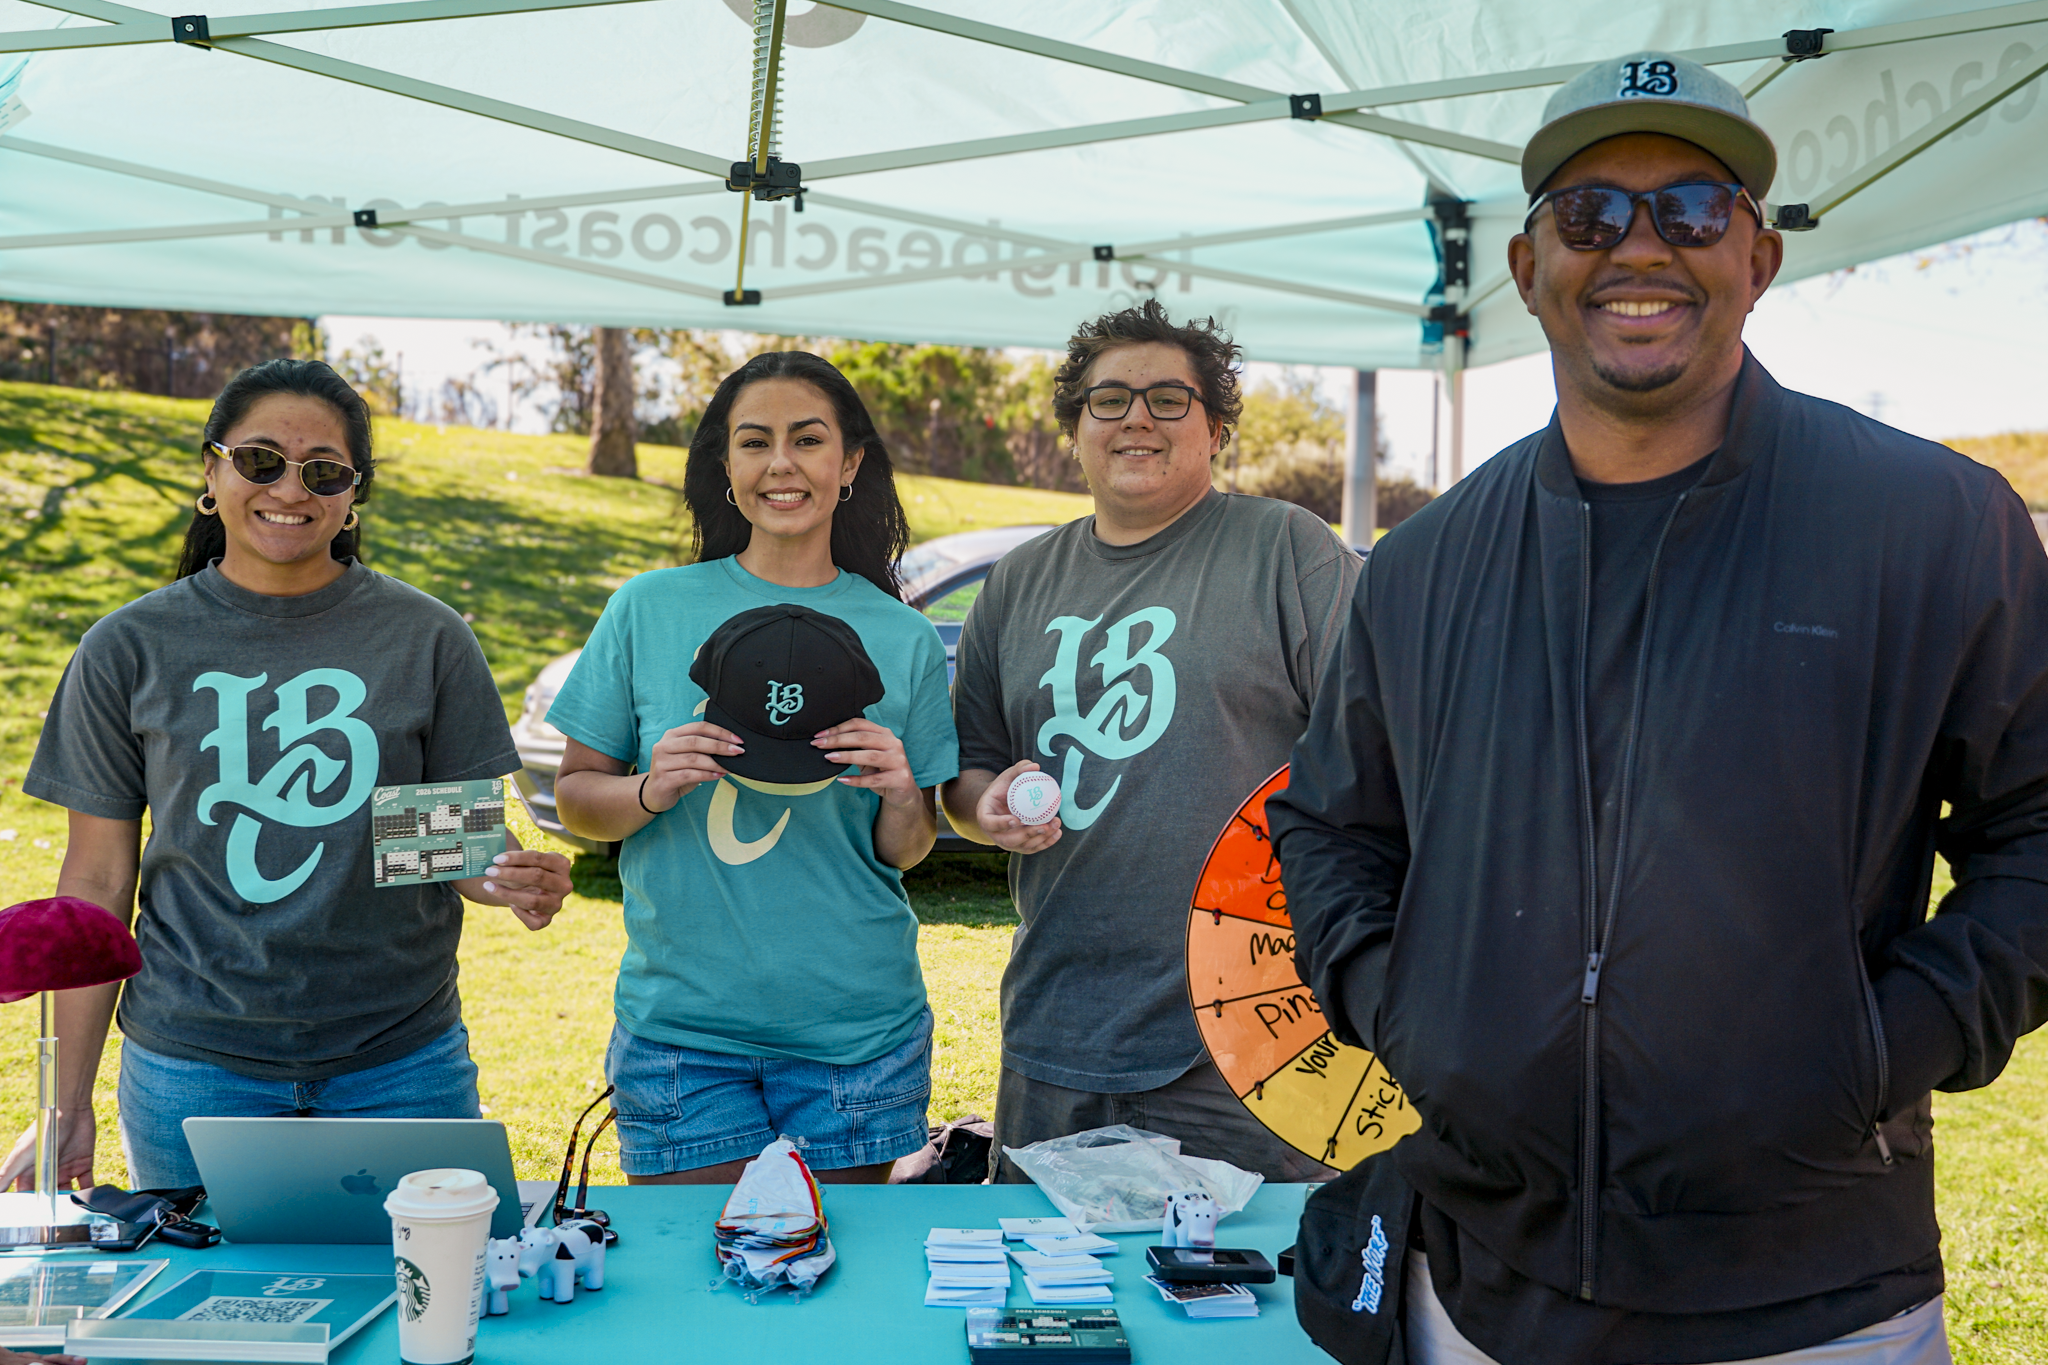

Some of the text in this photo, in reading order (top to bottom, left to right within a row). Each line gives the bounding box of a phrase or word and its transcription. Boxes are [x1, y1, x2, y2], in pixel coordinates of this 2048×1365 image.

[1620, 61, 1678, 97] LB
[1774, 621, 1838, 639] Calvin Klein
[374, 786, 401, 803] Coast
[415, 786, 463, 796] 2026 SCHEDULE
